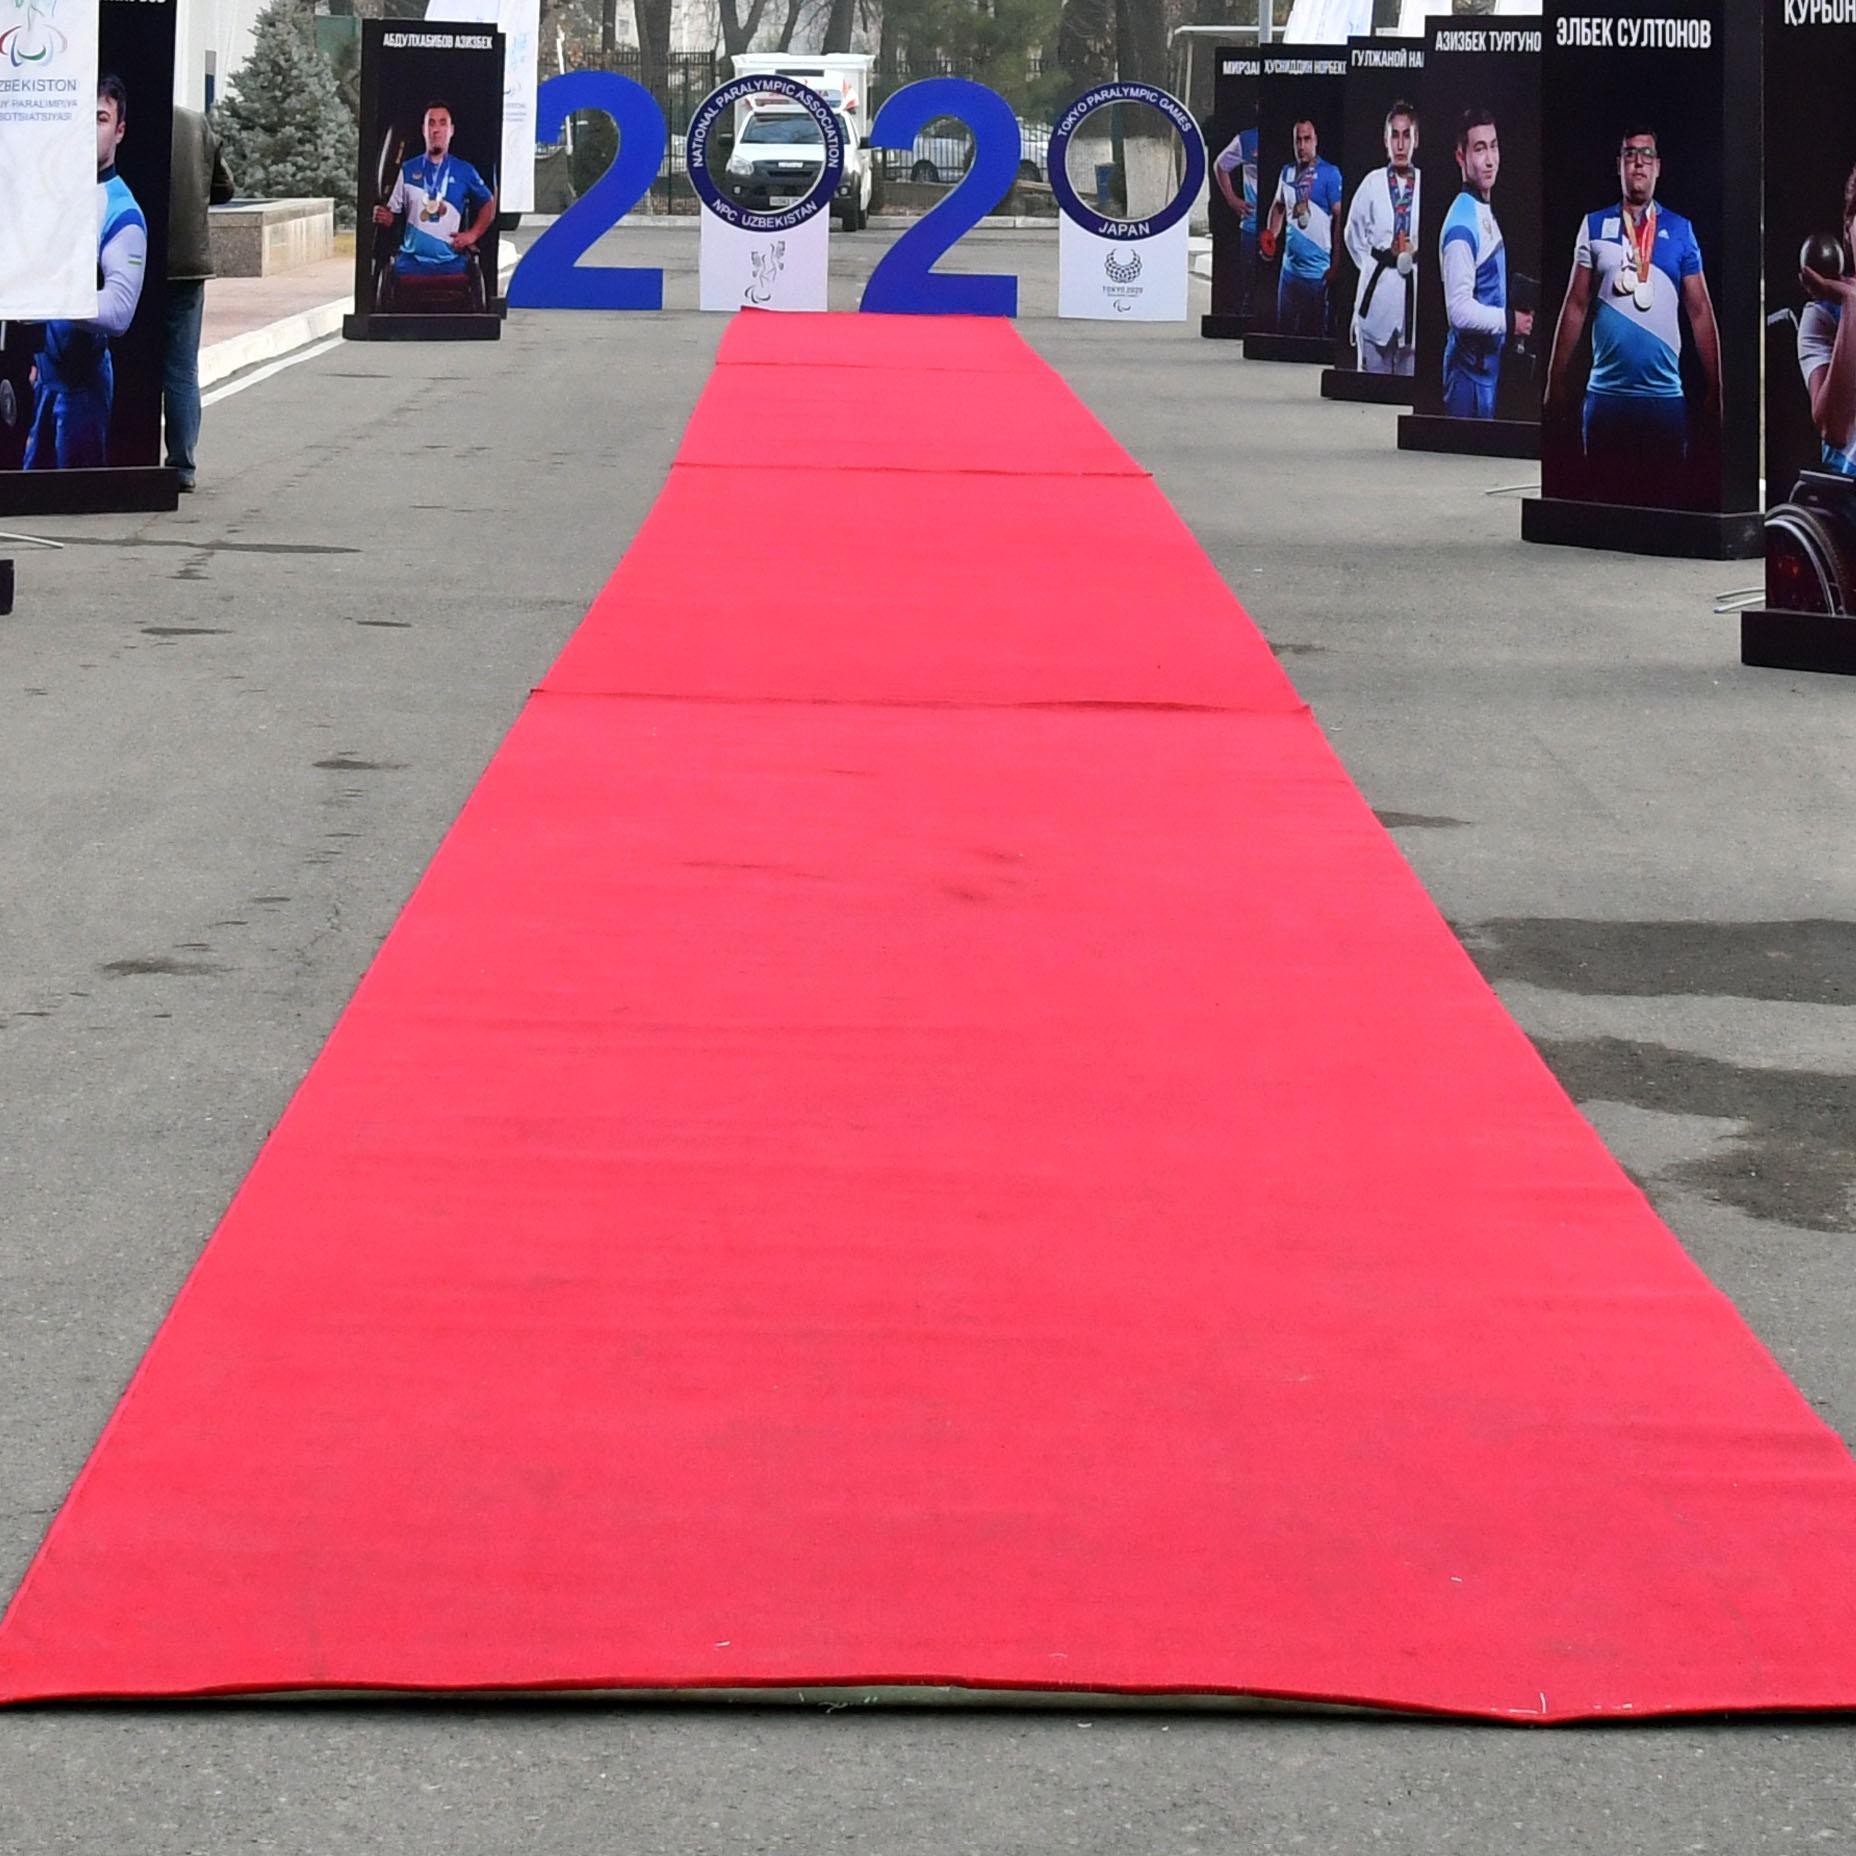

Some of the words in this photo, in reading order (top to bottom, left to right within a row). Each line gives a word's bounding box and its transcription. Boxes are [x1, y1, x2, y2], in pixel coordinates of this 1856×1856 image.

[1435, 31, 1486, 52] АЗИЗБЕК
[1556, 17, 1614, 47] ЭЛБЕК
[1617, 18, 1712, 49] СУЛТОНОВ
[1352, 48, 1407, 67] ГУЛЖАНОЙ
[691, 107, 720, 168] NATIONAL
[715, 79, 796, 109] PARALYMPIC
[795, 89, 841, 168] ASSOCIATION
[1057, 103, 1087, 138] TOKYO
[1087, 86, 1159, 111] PARALYMPIC
[1158, 97, 1193, 133] GAMES
[712, 198, 739, 222] NPC
[741, 201, 818, 228] UZBEKISTAN
[1098, 222, 1151, 236] JAPAN
